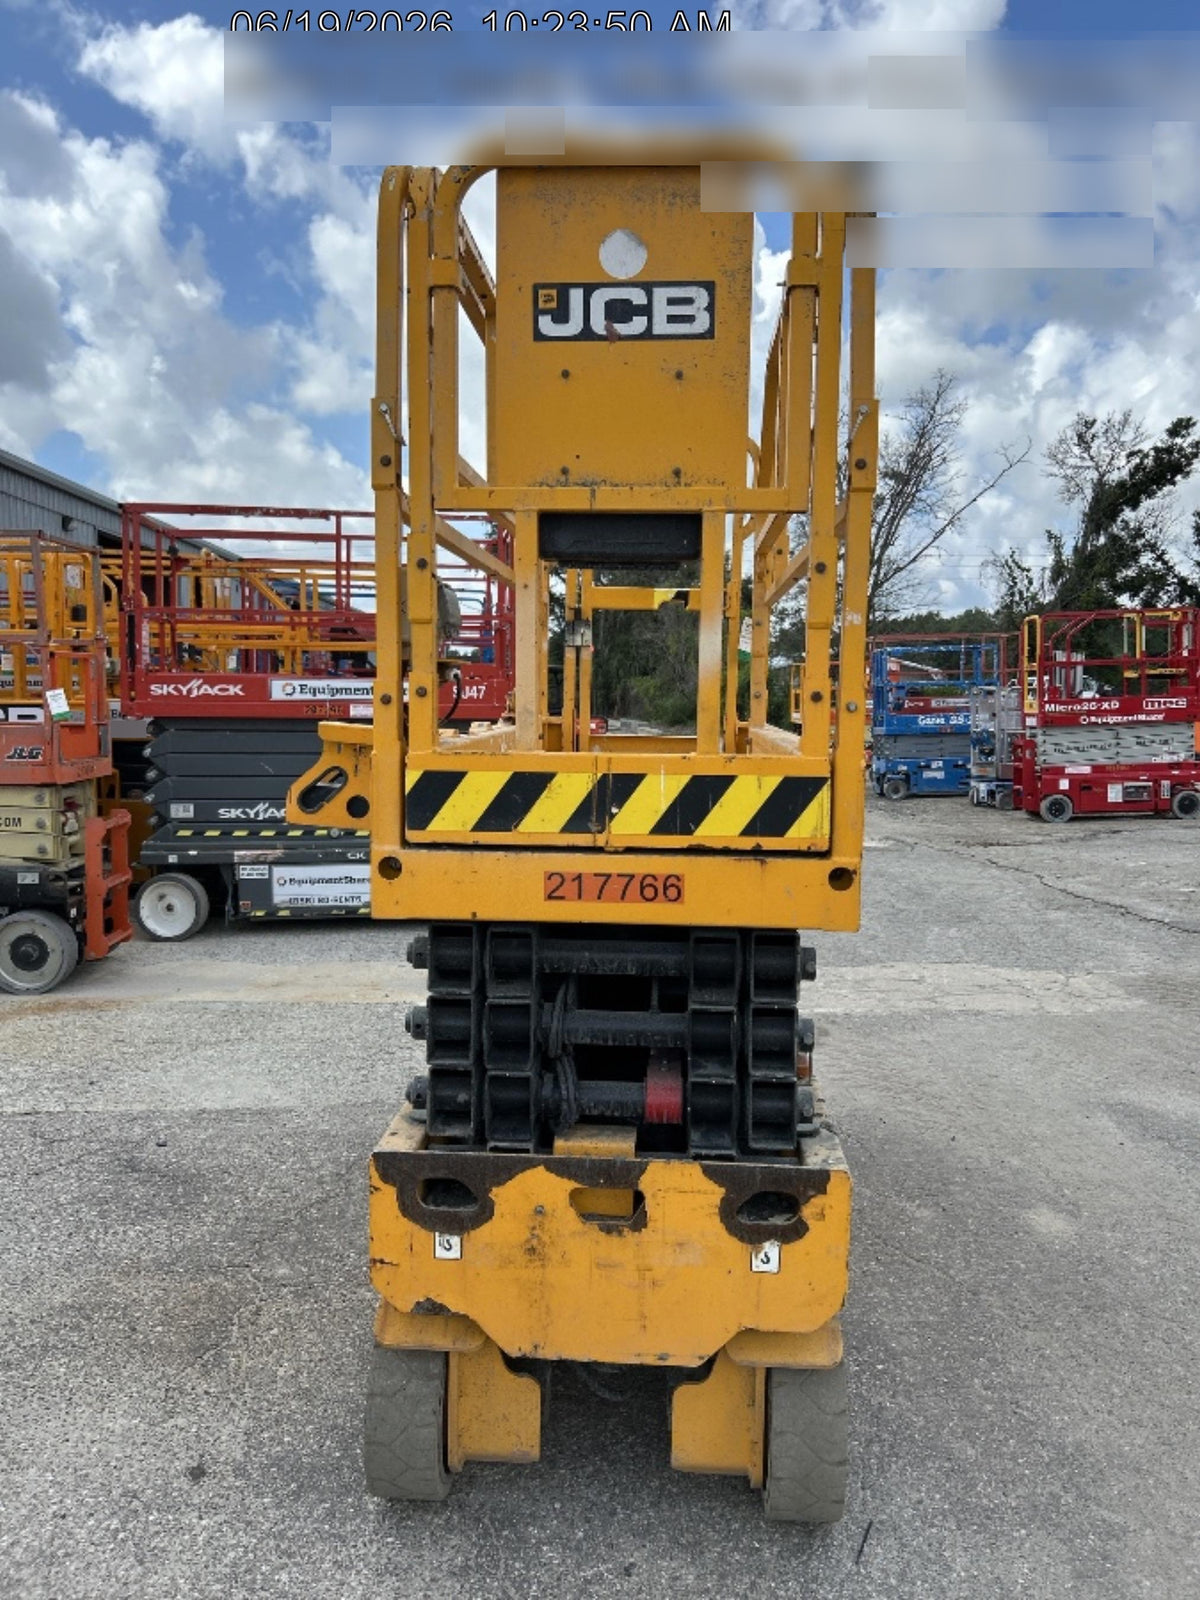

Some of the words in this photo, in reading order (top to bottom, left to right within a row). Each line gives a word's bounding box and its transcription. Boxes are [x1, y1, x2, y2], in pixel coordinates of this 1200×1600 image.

[538, 287, 711, 337] JCB
[149, 678, 246, 698] SKYJACK
[5, 747, 44, 761] JLG
[546, 872, 682, 902] 217766
